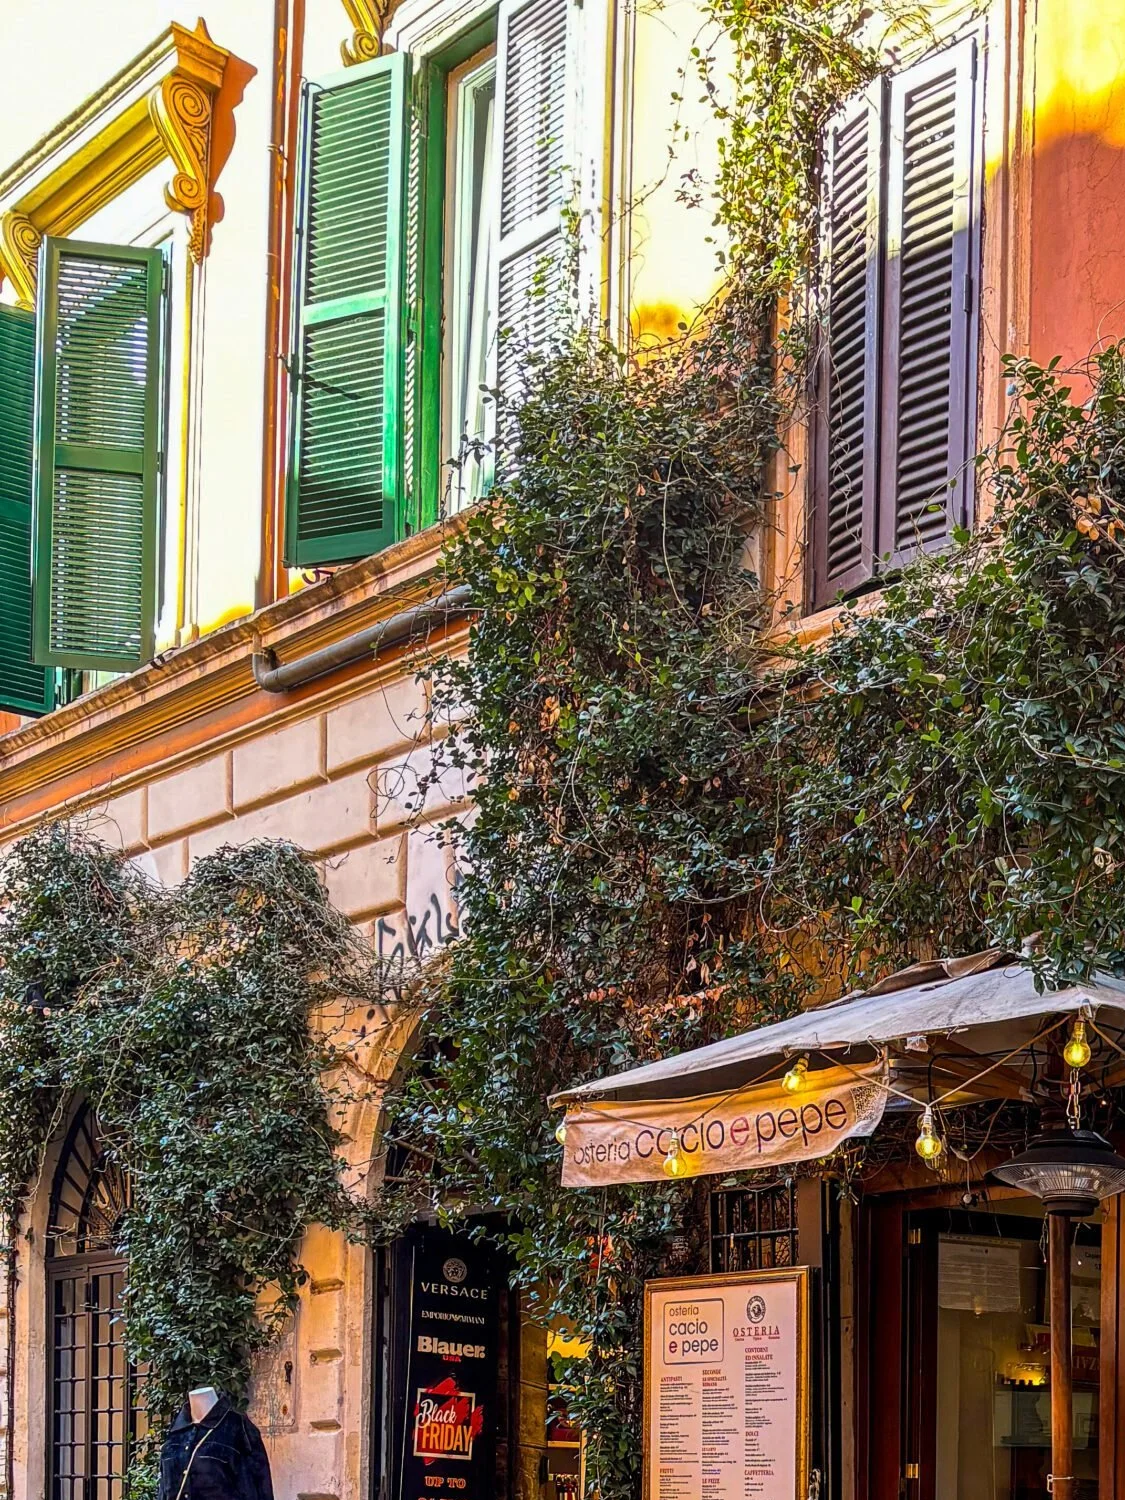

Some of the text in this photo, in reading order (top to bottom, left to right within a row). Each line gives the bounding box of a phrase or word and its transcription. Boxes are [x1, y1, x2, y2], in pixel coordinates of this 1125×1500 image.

[729, 1115, 750, 1147] e
[754, 1097, 848, 1154] pepe
[420, 1281, 488, 1300] VERSACE
[669, 1304, 699, 1317] osteria
[668, 1318, 708, 1336] cacio
[732, 1325, 780, 1337] OSTERIA
[668, 1338, 719, 1357] e pepe
[418, 1398, 458, 1429] Black
[421, 1421, 473, 1452] FRIDAY
[424, 1475, 466, 1489] UP TO
